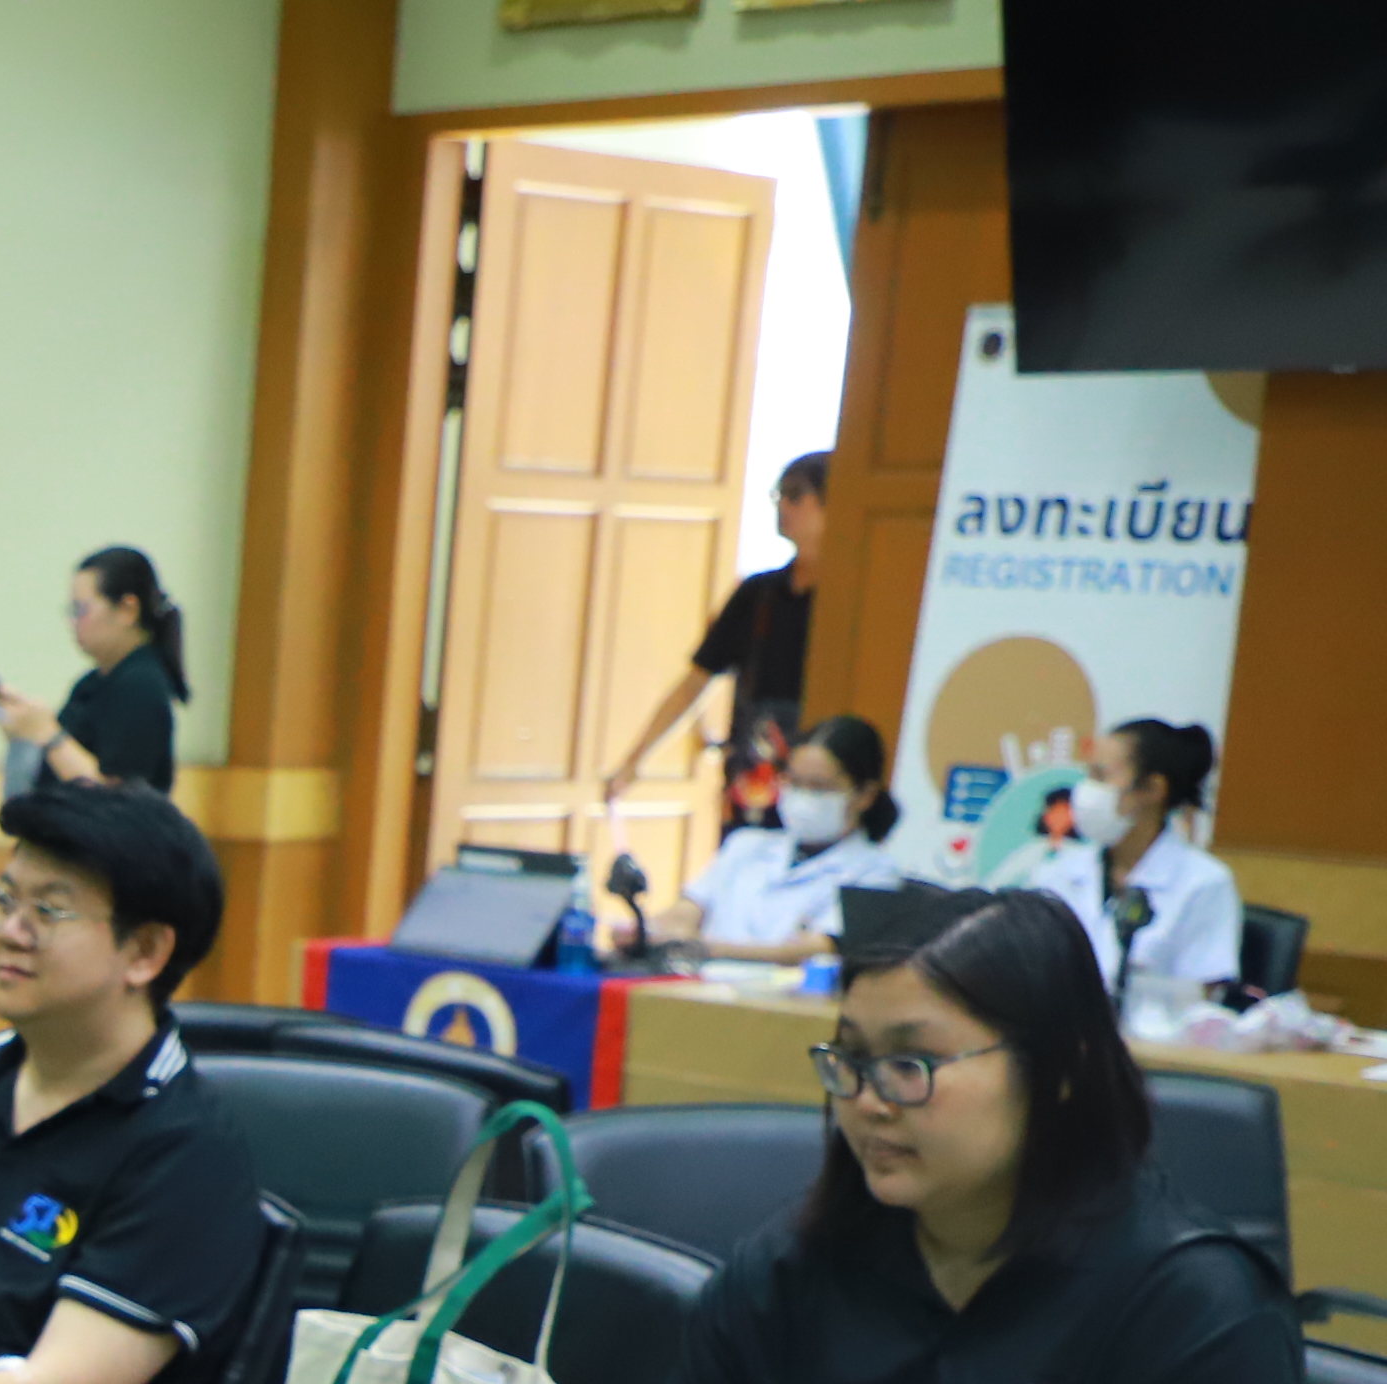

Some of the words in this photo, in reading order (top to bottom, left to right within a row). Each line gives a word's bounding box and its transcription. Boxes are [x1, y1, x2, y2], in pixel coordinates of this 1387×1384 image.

[955, 479, 1251, 542] ลงทะเบียน
[941, 554, 1235, 595] REGISTRATION
